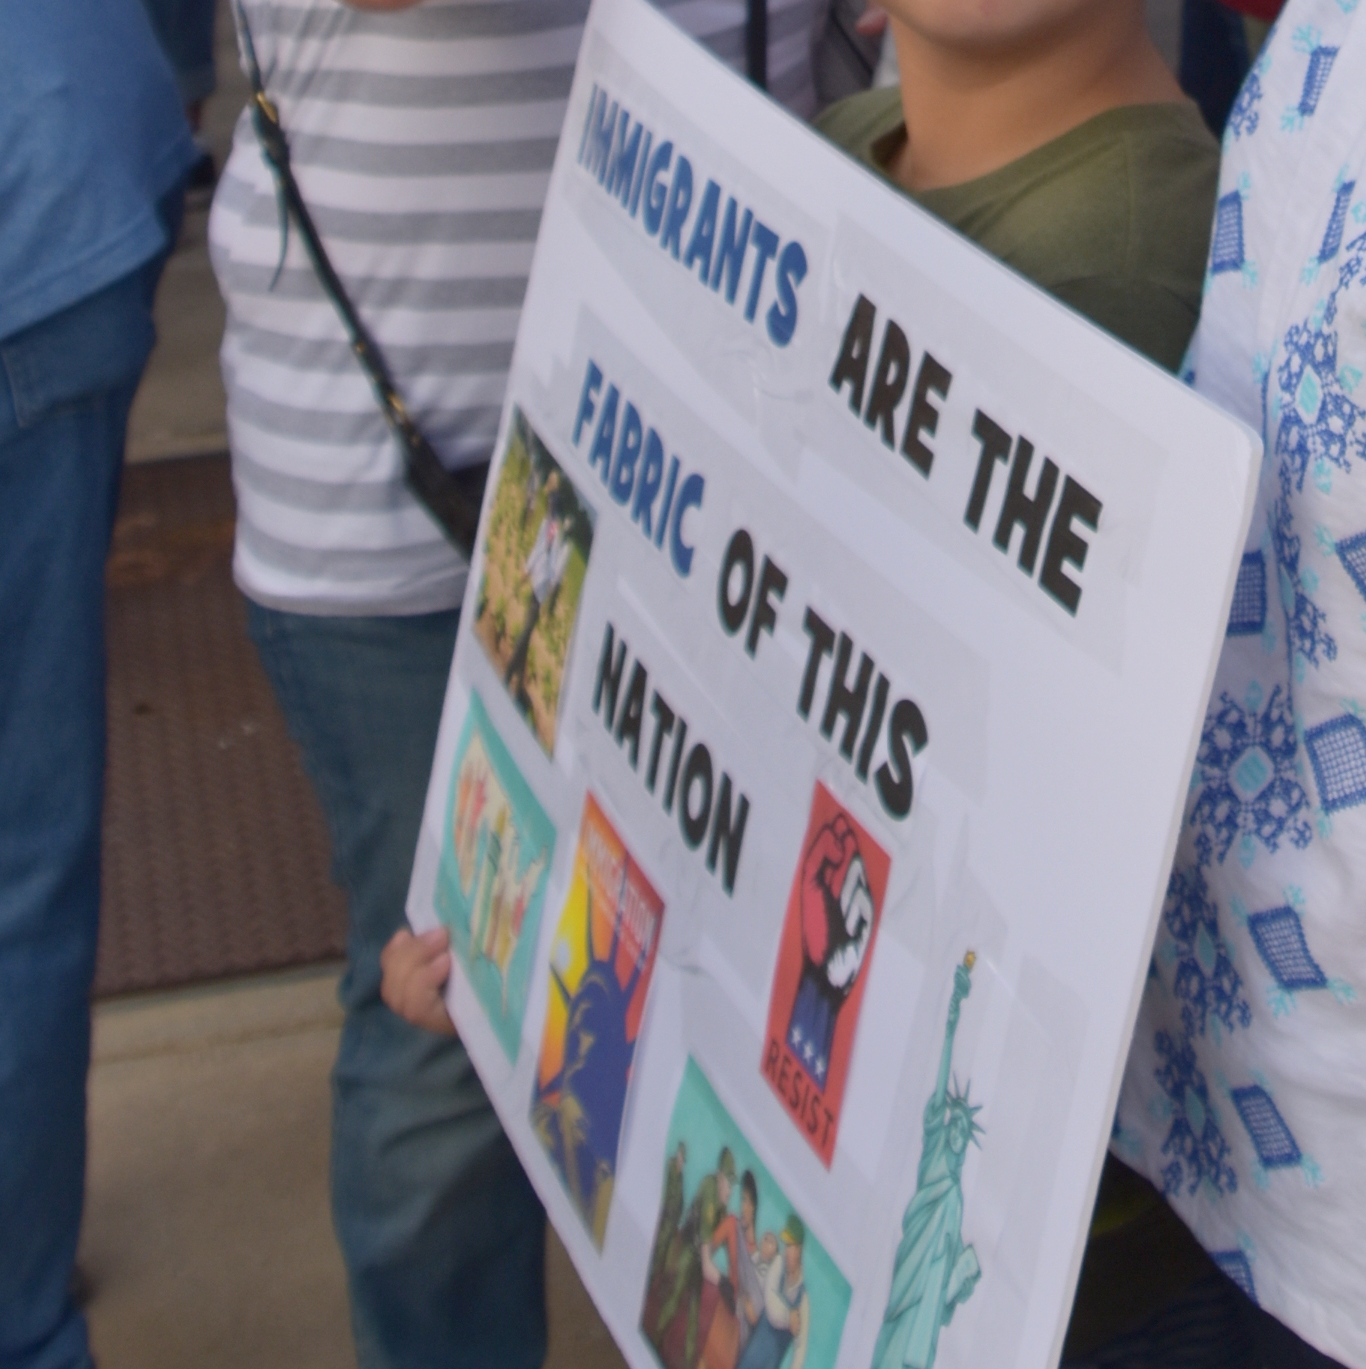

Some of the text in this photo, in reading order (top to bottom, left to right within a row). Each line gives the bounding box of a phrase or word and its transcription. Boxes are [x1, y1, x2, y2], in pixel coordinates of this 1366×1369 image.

[577, 83, 1103, 617] IMMIGRANTS ARE THE
[572, 359, 928, 821] FABRIC OF THIS
[592, 621, 750, 898] NATION
[765, 1037, 834, 1150] RESIST
